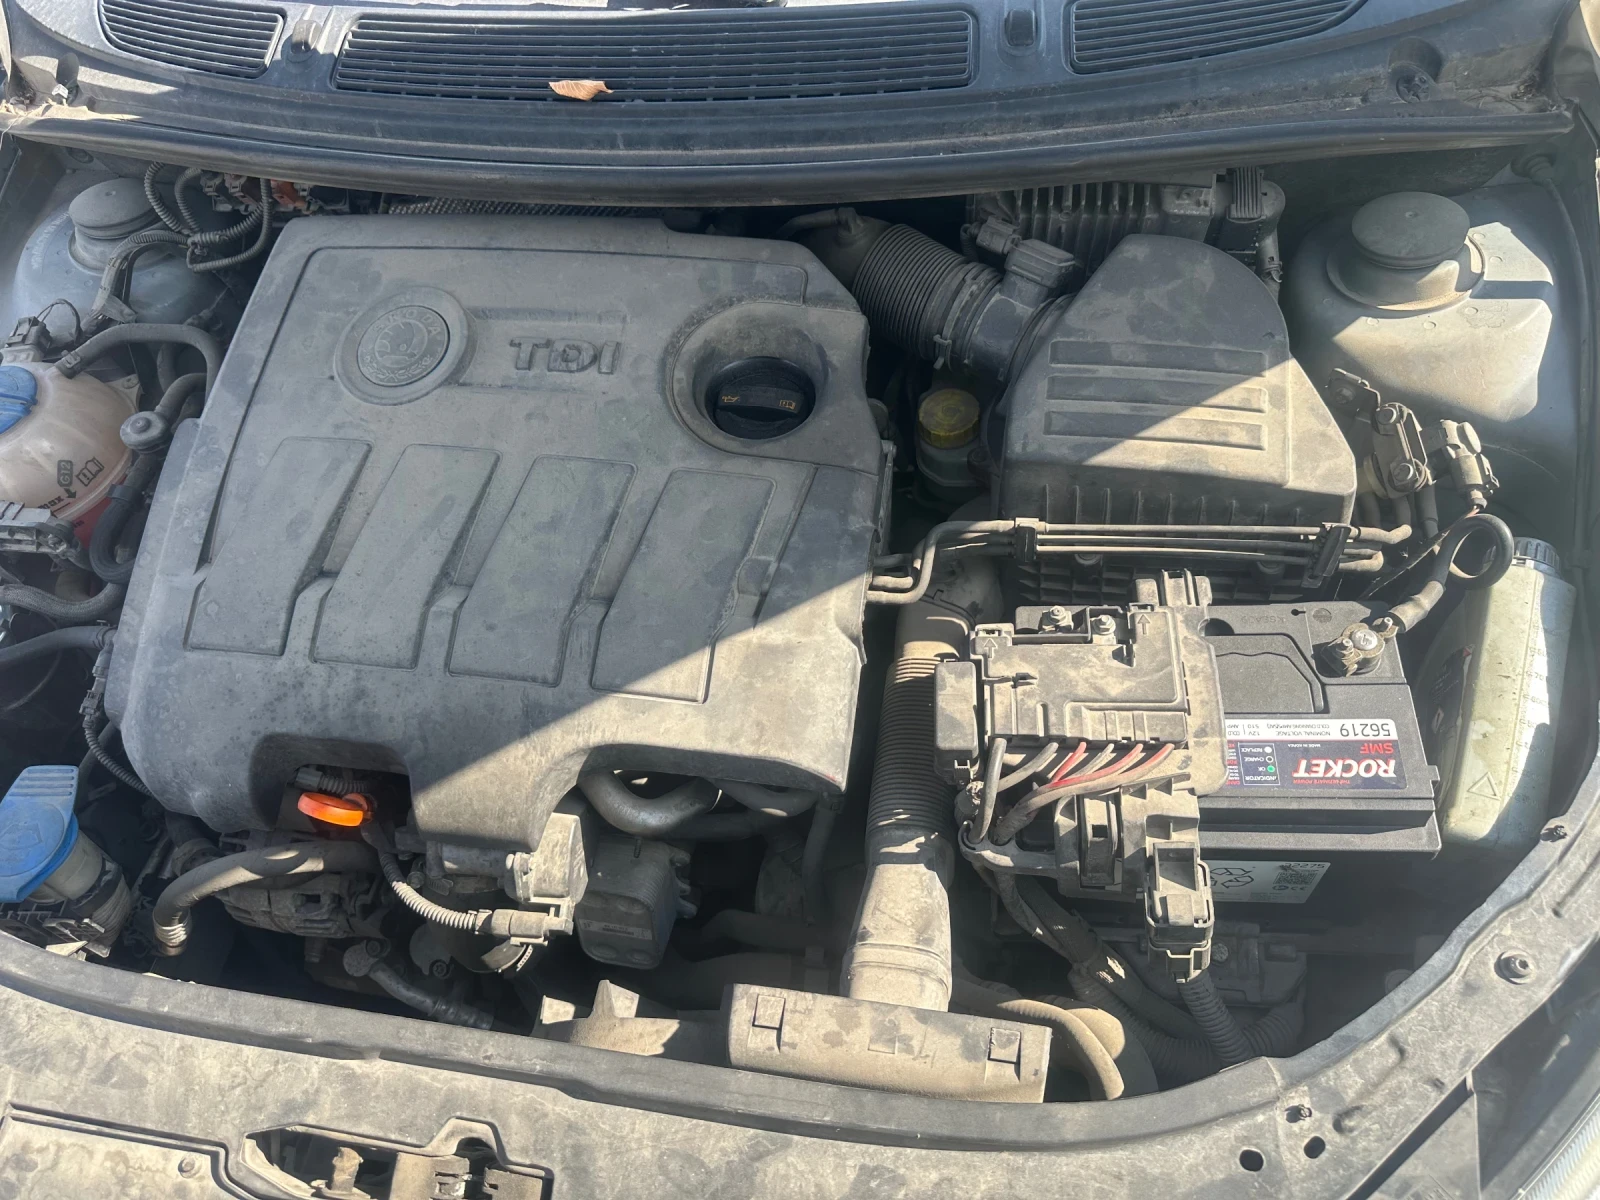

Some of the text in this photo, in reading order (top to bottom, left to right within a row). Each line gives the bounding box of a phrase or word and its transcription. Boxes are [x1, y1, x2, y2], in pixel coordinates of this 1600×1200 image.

[509, 336, 622, 375] TDI
[60, 461, 72, 485] G12
[1339, 723, 1391, 737] 56219
[1359, 742, 1394, 755] SMF
[1291, 758, 1397, 778] ROCKET
